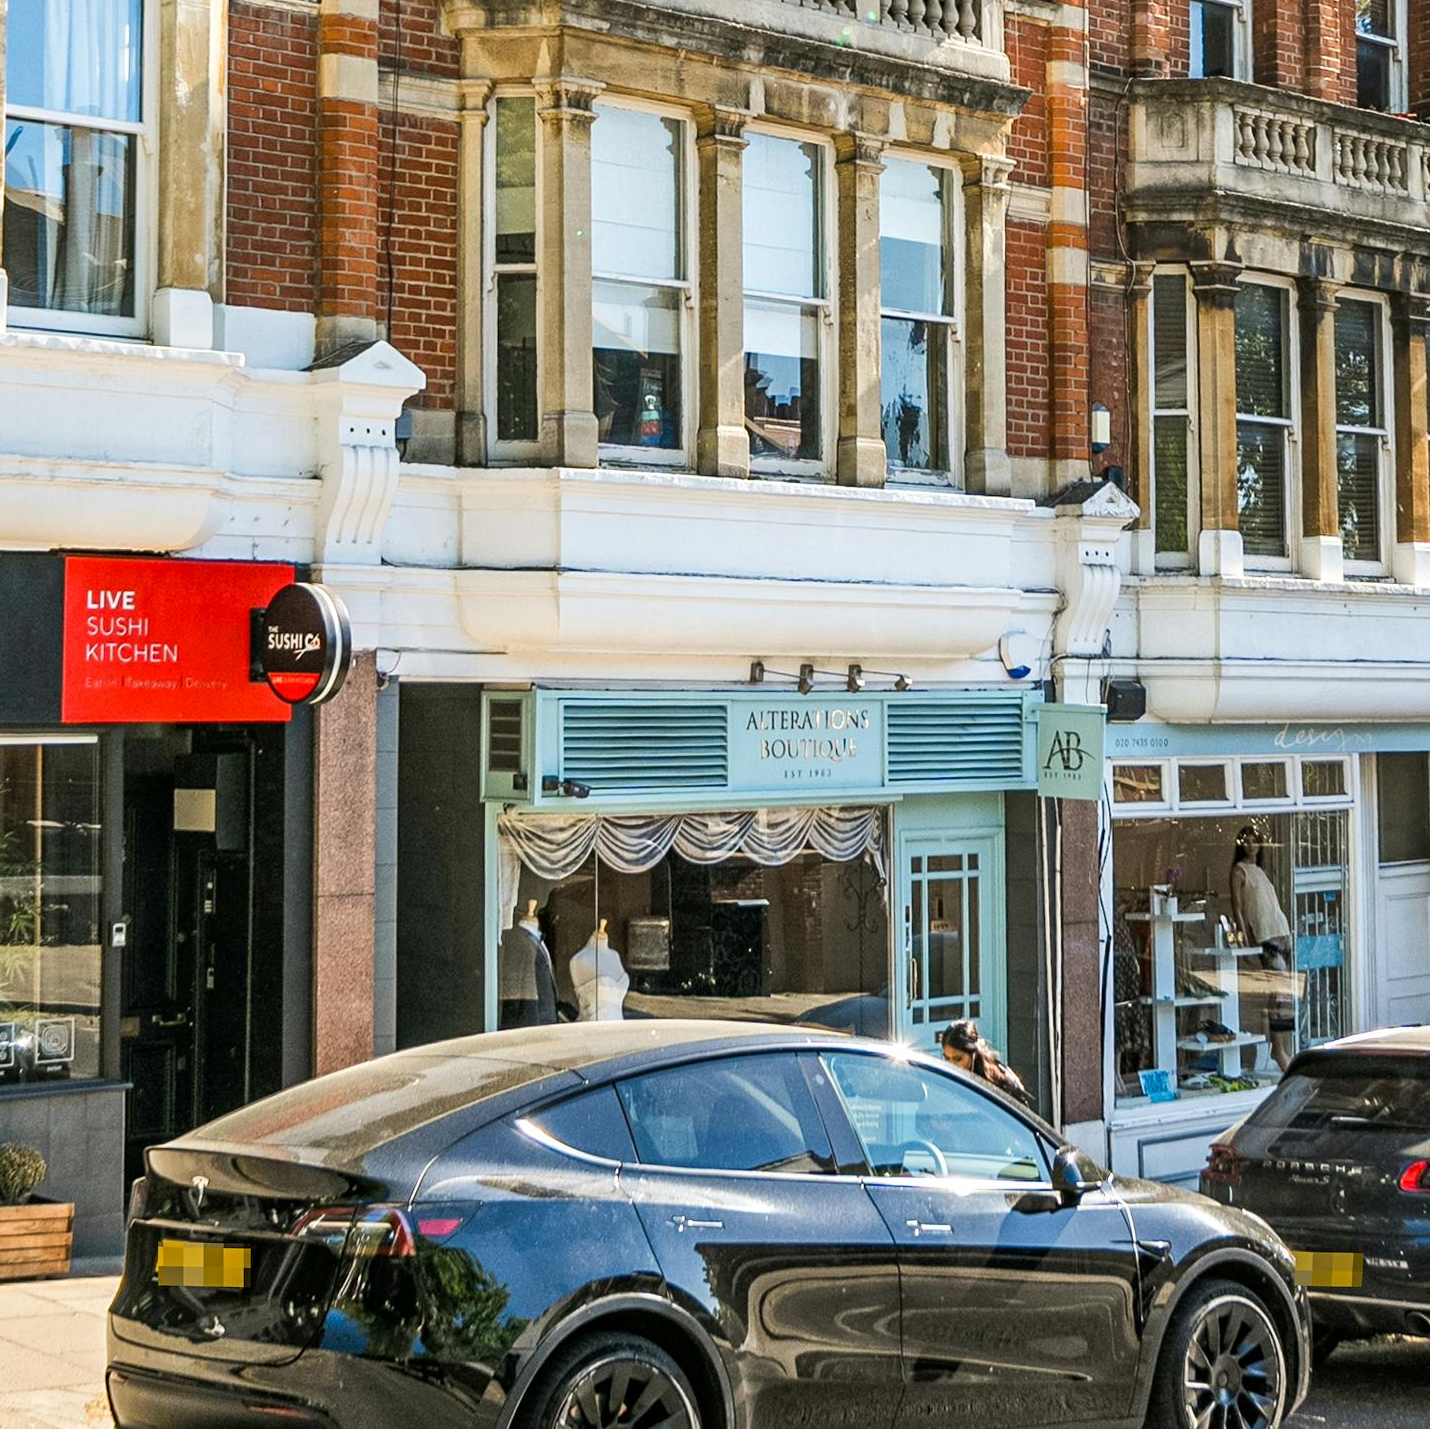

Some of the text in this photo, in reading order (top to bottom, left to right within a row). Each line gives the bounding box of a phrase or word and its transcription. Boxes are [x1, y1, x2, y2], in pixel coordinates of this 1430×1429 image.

[87, 590, 135, 610] LIVE
[87, 617, 149, 636] SUSHI
[268, 633, 303, 649] SUSHI
[86, 643, 178, 663] KITCHEN
[125, 676, 177, 690] Takeaway
[185, 677, 227, 689] Delivery
[746, 709, 870, 730] ALTERATIONS
[760, 737, 856, 762] BOUTIQUE
[1043, 730, 1084, 771] AB
[1114, 738, 1169, 748] 020 7435 0100
[784, 769, 802, 778] EST
[1044, 771, 1082, 781] EST 1983
[1263, 1160, 1362, 1174] PORSCHE
